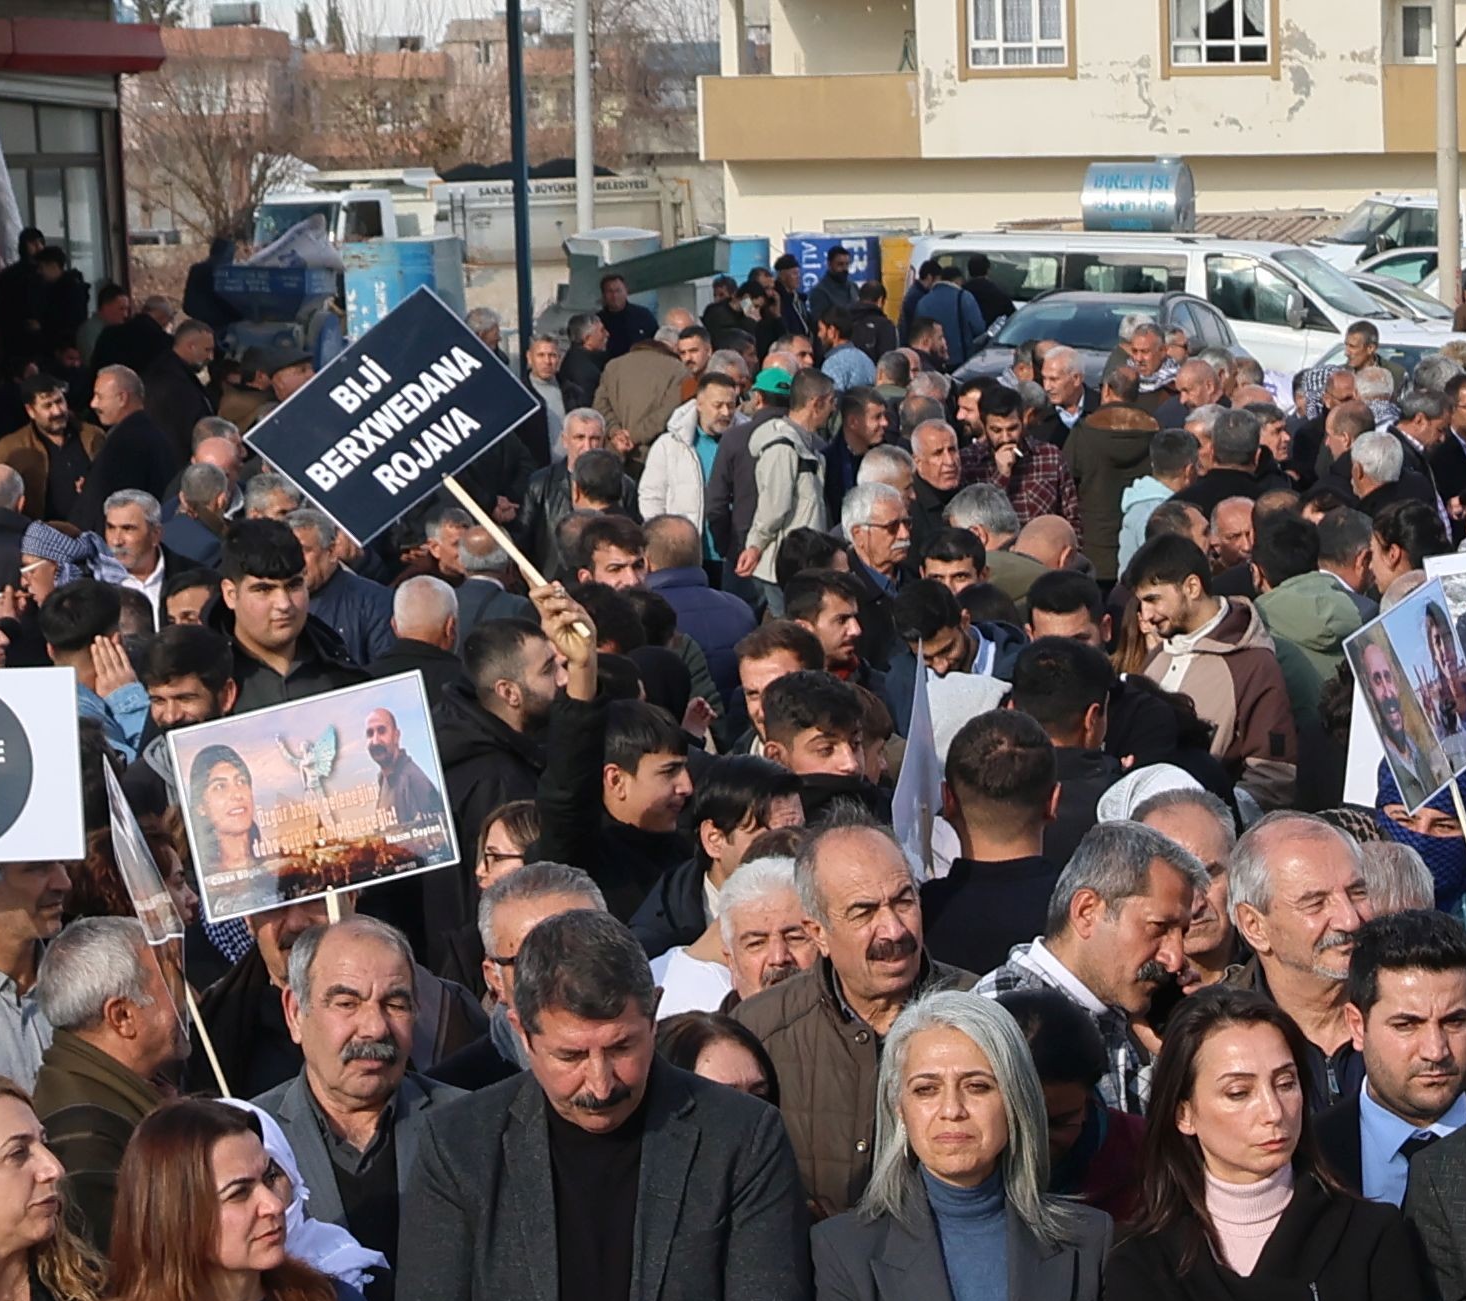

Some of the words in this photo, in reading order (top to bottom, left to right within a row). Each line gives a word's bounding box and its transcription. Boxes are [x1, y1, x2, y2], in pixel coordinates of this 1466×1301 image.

[535, 183, 577, 195] BÜYÜKŞE
[305, 346, 483, 492] BERXWEDANA
[372, 407, 482, 495] ROJAVA
